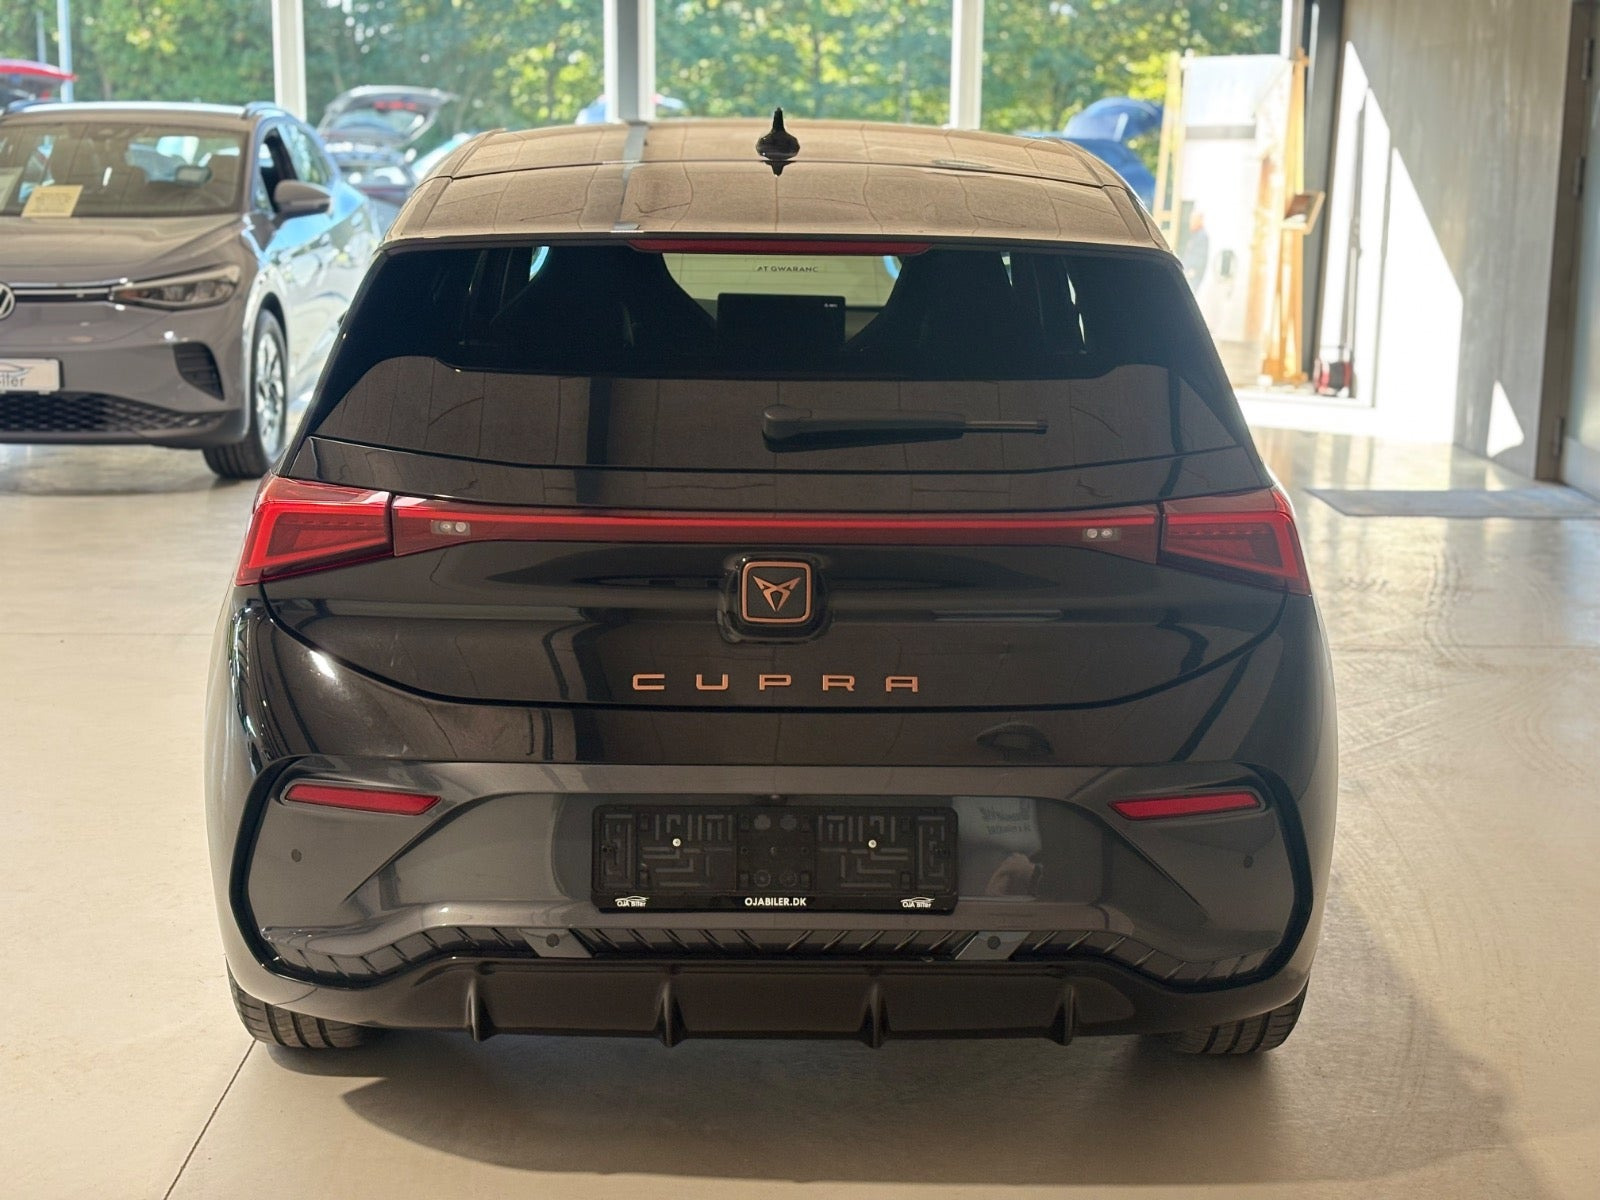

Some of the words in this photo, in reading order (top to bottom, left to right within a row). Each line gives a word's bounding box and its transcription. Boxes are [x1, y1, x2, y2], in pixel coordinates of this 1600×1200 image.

[0, 371, 25, 387] iler
[632, 673, 919, 693] CUPRA
[744, 897, 807, 906] OJABILER.DK
